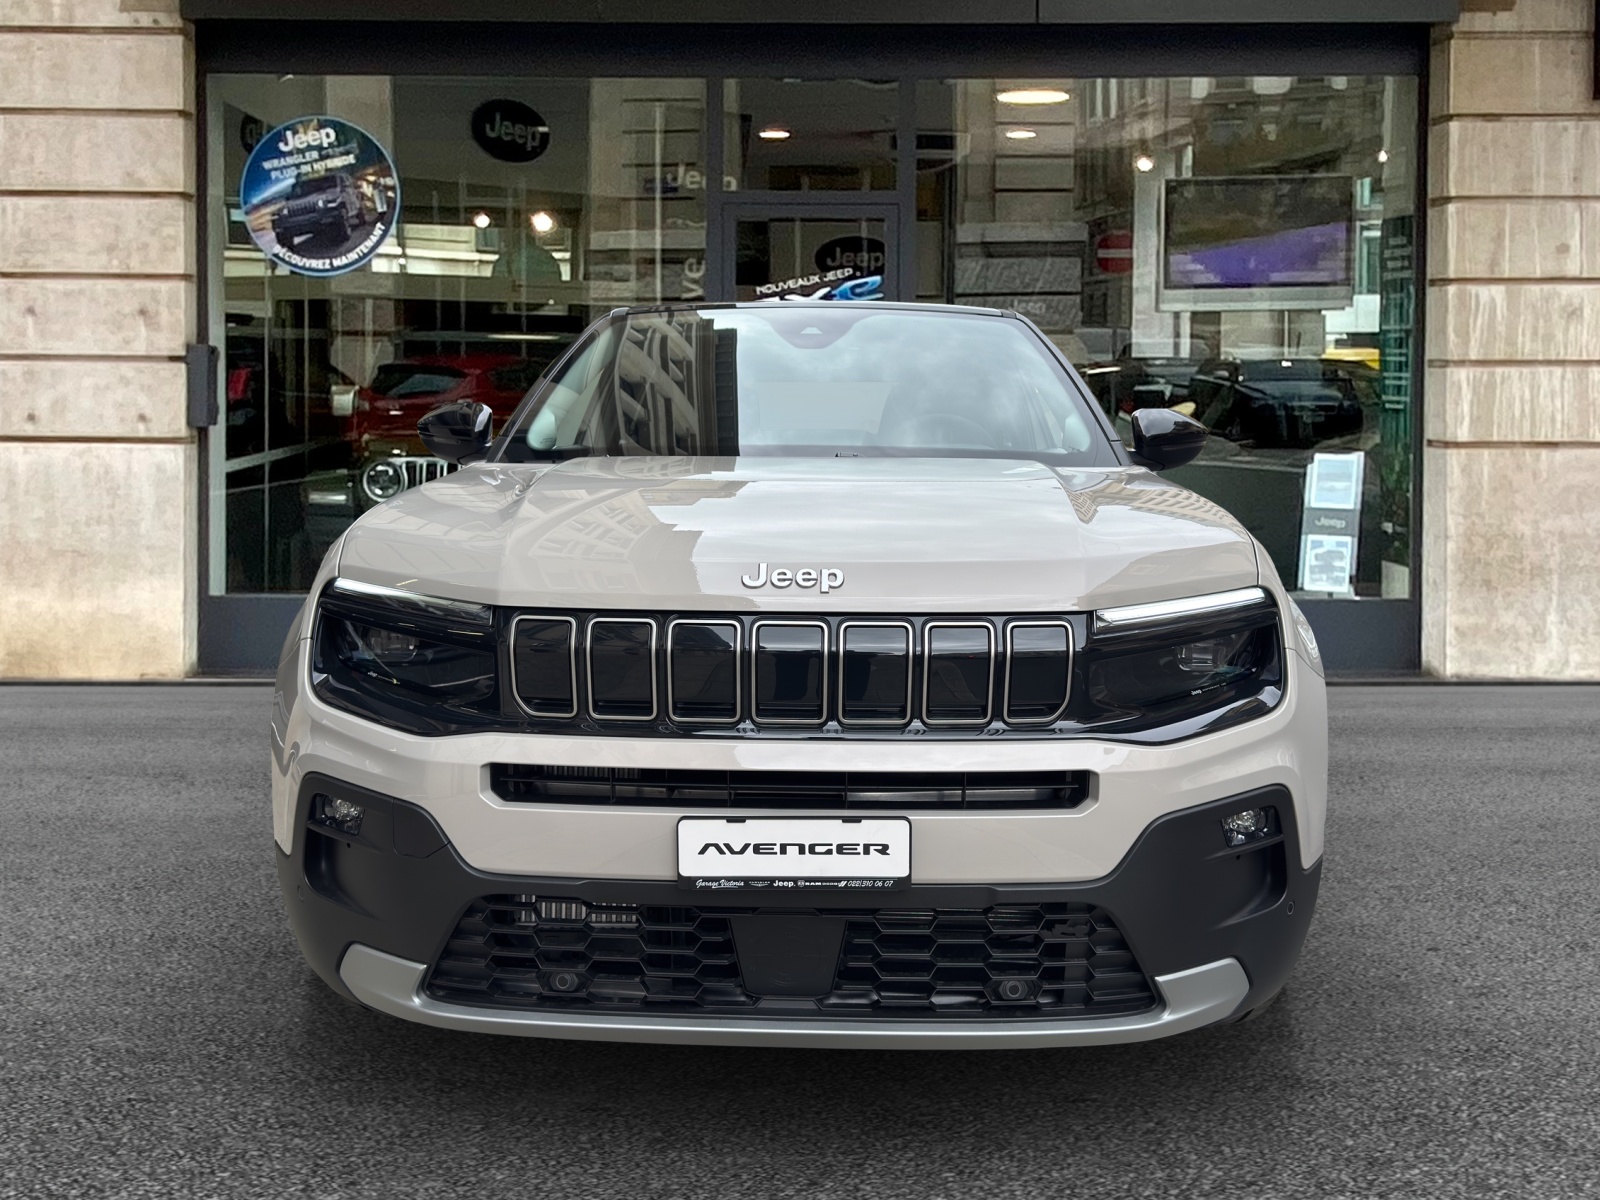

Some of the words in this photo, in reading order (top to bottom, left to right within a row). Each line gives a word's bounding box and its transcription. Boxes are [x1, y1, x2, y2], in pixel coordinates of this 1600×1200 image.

[278, 126, 337, 152] Jeep
[485, 112, 541, 151] Jeep
[262, 150, 320, 171] WRANGLER
[270, 163, 313, 181] PLUG-IN
[272, 243, 331, 269] DÉCOUVREZ
[332, 221, 386, 268] MAINTENANT
[826, 246, 884, 272] Jeep
[755, 274, 821, 296] NOUVEAUX
[822, 267, 854, 282] JEEP
[741, 562, 845, 594] Jeep
[697, 842, 891, 856] AVENGER
[695, 878, 720, 889] Garage
[719, 879, 745, 889] Victoria
[773, 879, 794, 888] Jeep
